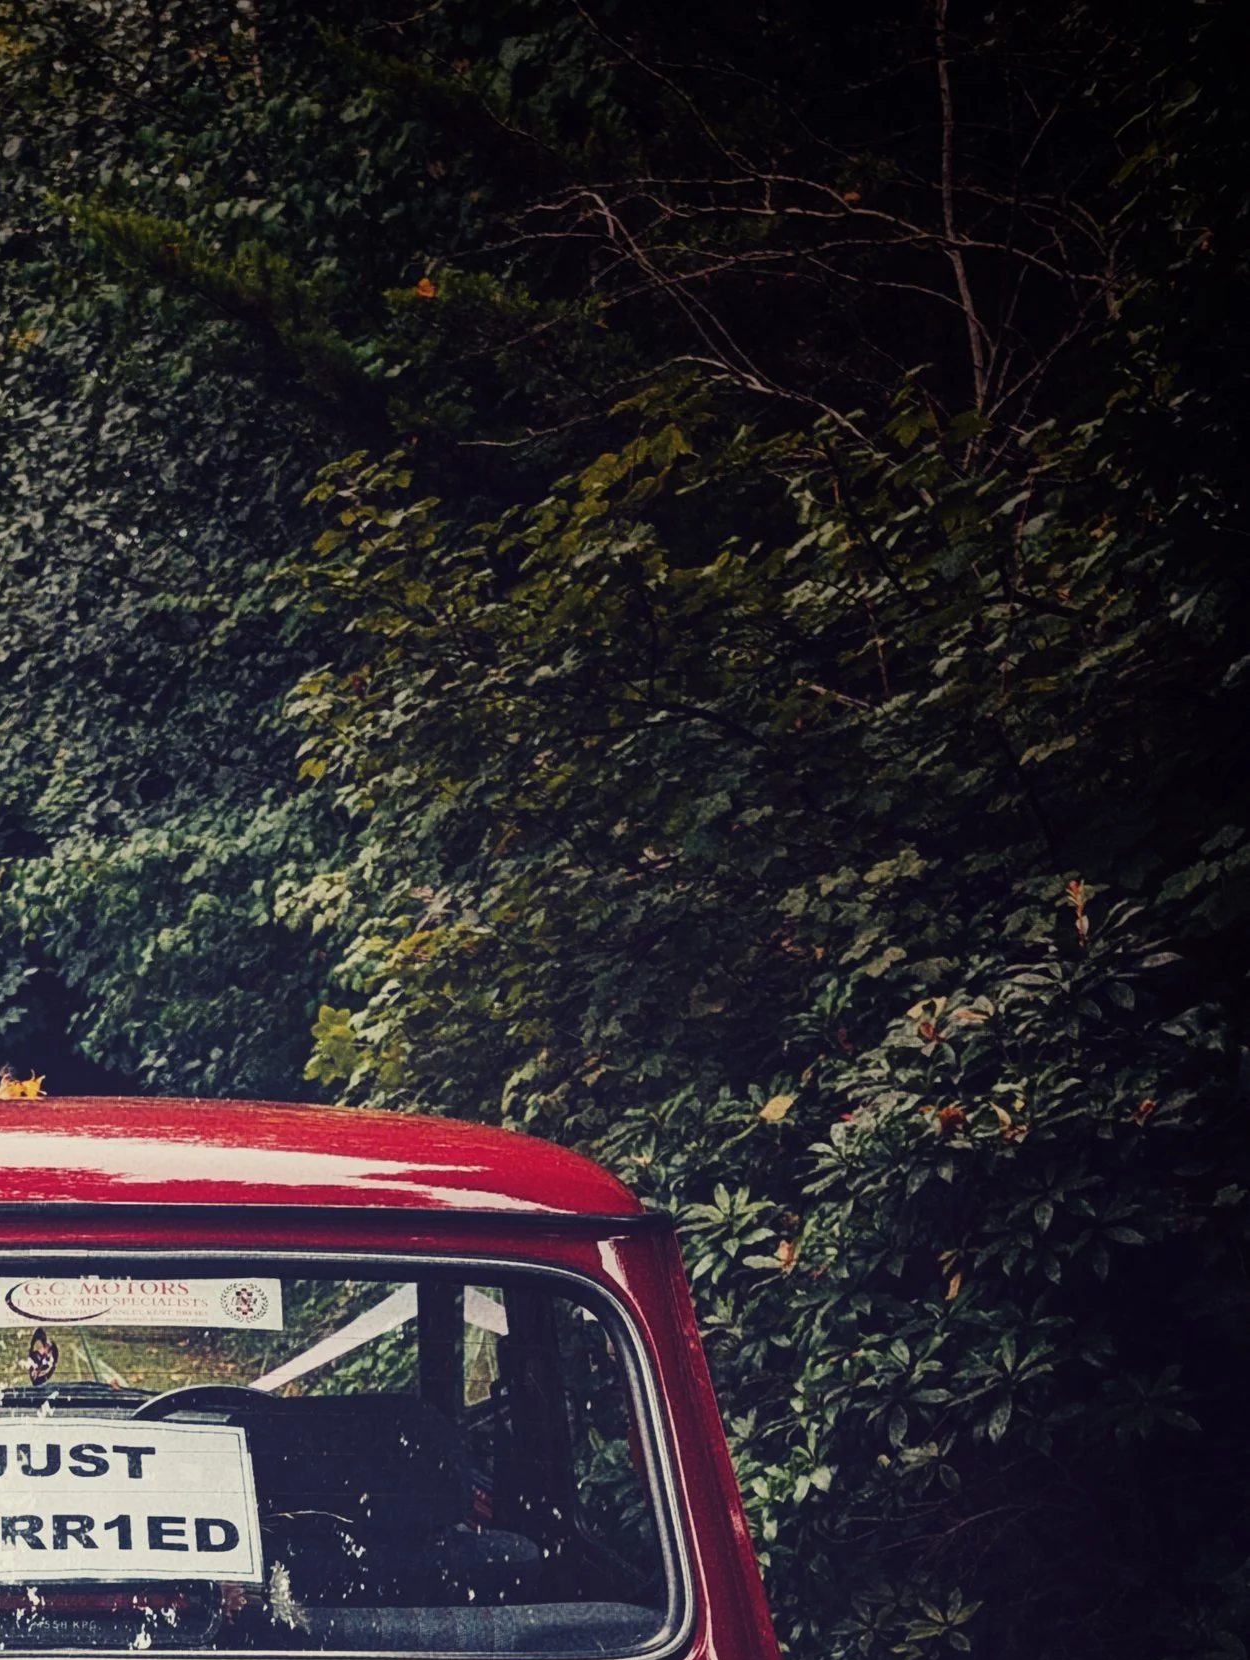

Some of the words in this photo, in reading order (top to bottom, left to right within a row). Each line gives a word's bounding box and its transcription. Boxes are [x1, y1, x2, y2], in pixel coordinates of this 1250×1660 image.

[80, 1281, 190, 1296] MOTORS
[13, 1297, 65, 1308] LASSIC
[73, 1297, 110, 1307] MINI
[112, 1297, 209, 1308] SPECIALISTS
